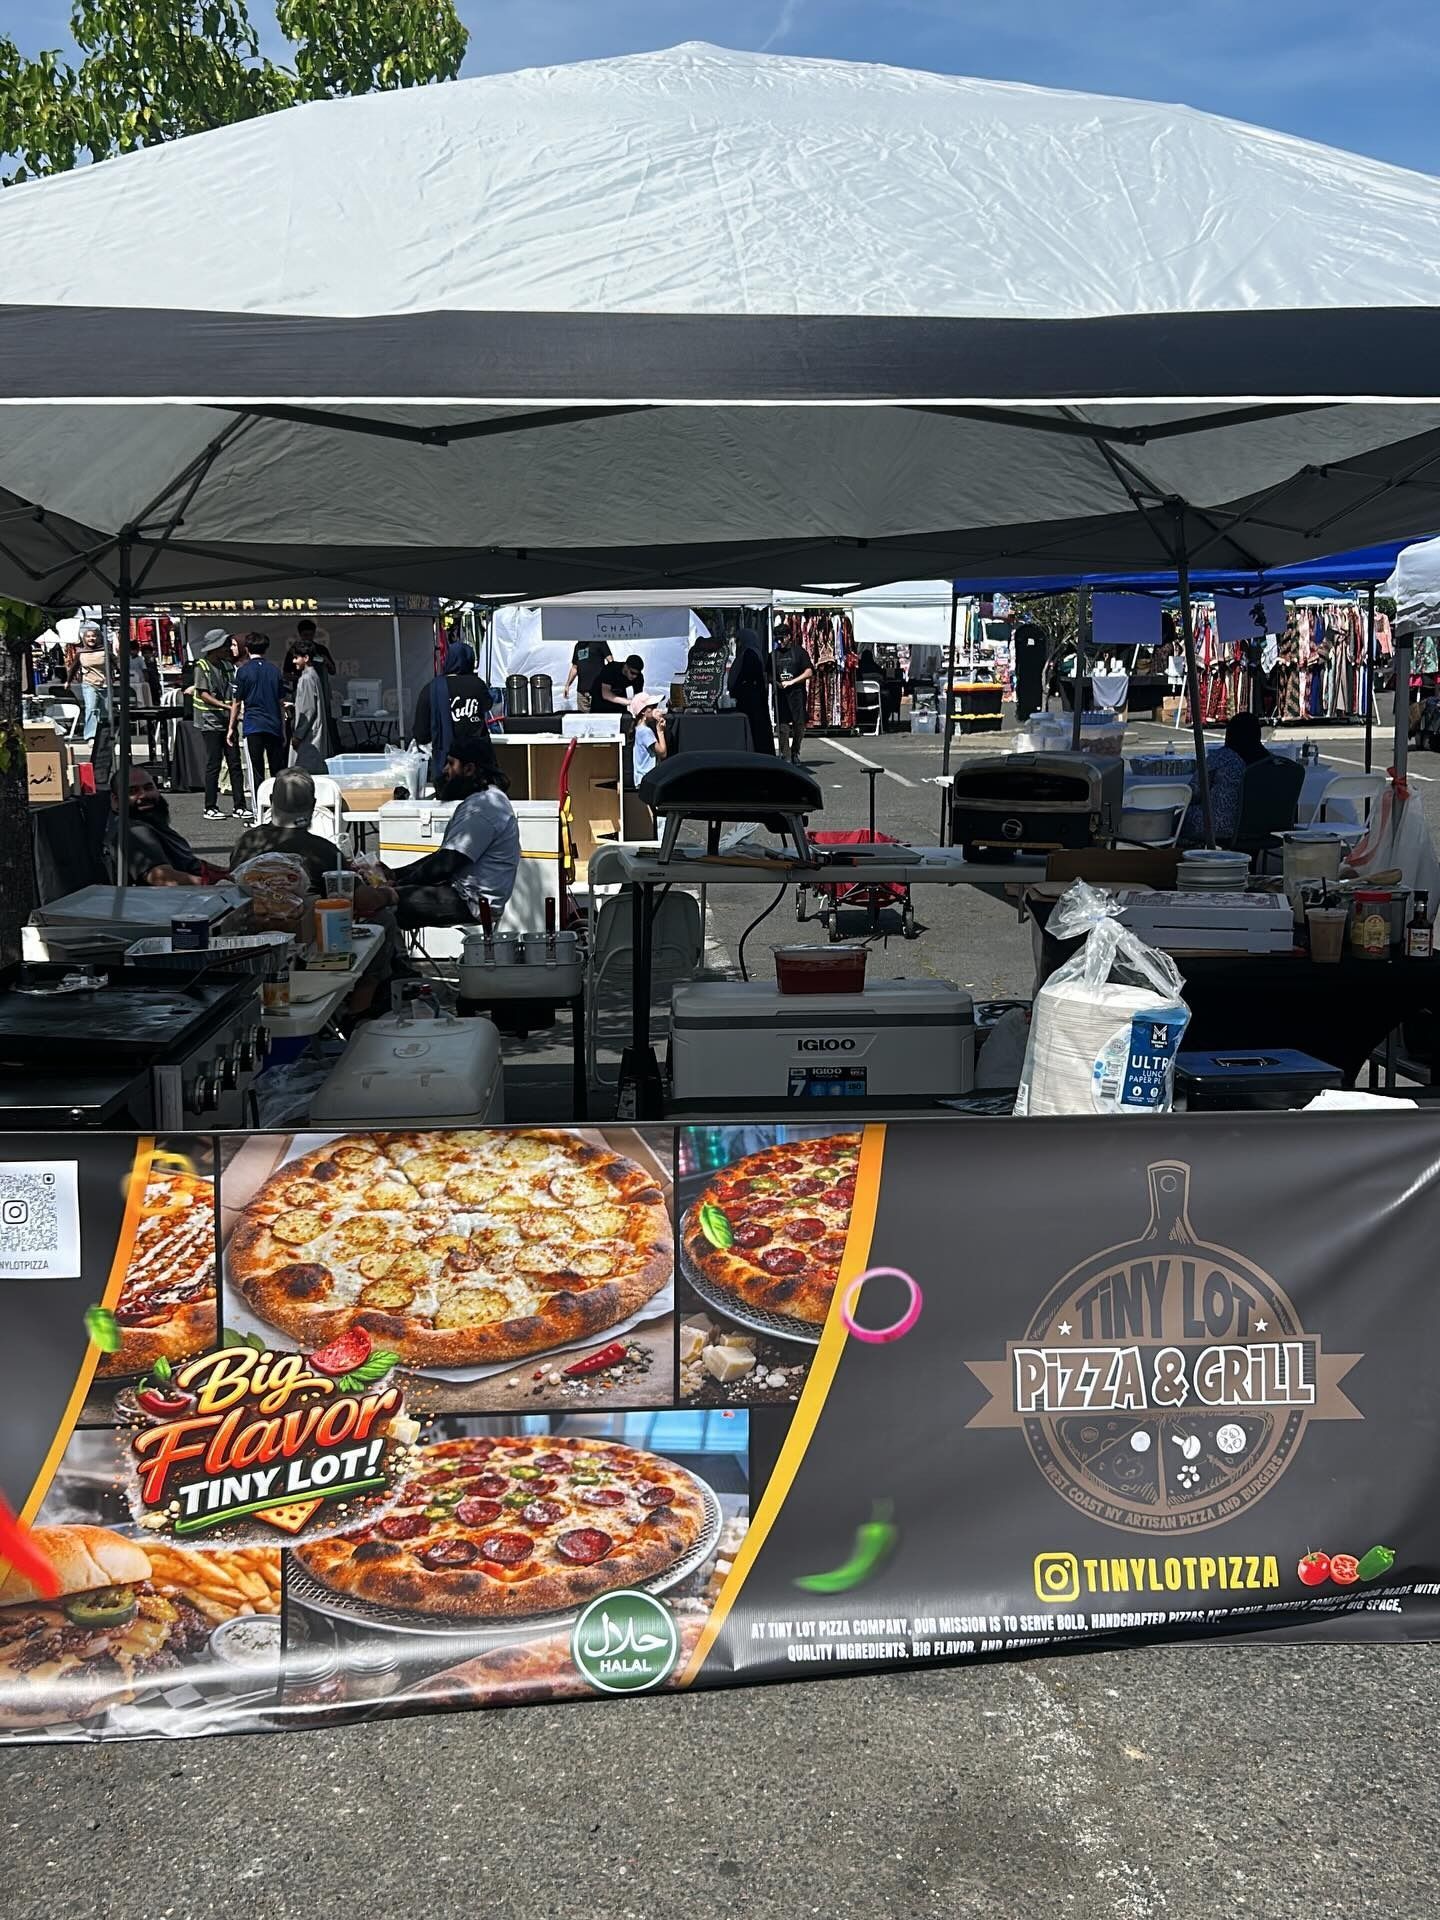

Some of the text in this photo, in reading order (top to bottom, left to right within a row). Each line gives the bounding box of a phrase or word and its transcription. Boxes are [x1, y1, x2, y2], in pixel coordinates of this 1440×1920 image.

[798, 1039, 856, 1051] IGLOO
[1132, 1055, 1171, 1070] ULTR
[1129, 1074, 1152, 1084] PAPER
[1143, 1070, 1164, 1078] LUNC
[1181, 1261, 1256, 1338] LOT
[176, 1346, 335, 1414] Big
[1151, 1347, 1191, 1408] &
[134, 1388, 400, 1504] Flavor
[178, 1438, 384, 1515] TINY LOT!
[1043, 1455, 1284, 1529] WEST COAST NY ARTISAN PIZZA AND BURGERS
[1083, 1555, 1280, 1592] TINYLOTPIZZA
[584, 1611, 668, 1657] حلال
[752, 1623, 765, 1639] AT
[768, 1622, 792, 1638] TINY
[796, 1621, 816, 1637] LOT
[819, 1620, 850, 1636] PIZZA
[853, 1618, 912, 1636] COMPANY,
[914, 1617, 936, 1633] OUR
[939, 1616, 987, 1633] MISSION
[989, 1615, 1001, 1632] IS
[1003, 1615, 1018, 1632] TO
[1020, 1614, 1054, 1631] SERVE
[1057, 1613, 1088, 1631] BOLD,
[1091, 1612, 1166, 1629] HANDCRAFTED
[1382, 1585, 1412, 1595] MADE
[1413, 1583, 1440, 1595] WITH
[788, 1643, 833, 1662] QUALITY
[836, 1642, 909, 1660] INGREDIENTS,
[912, 1641, 931, 1657] BIG
[981, 1639, 1003, 1652] AND
[1347, 1600, 1366, 1610] BIG
[1366, 1598, 1403, 1614] SPACE,
[600, 1659, 652, 1673] HALAL
